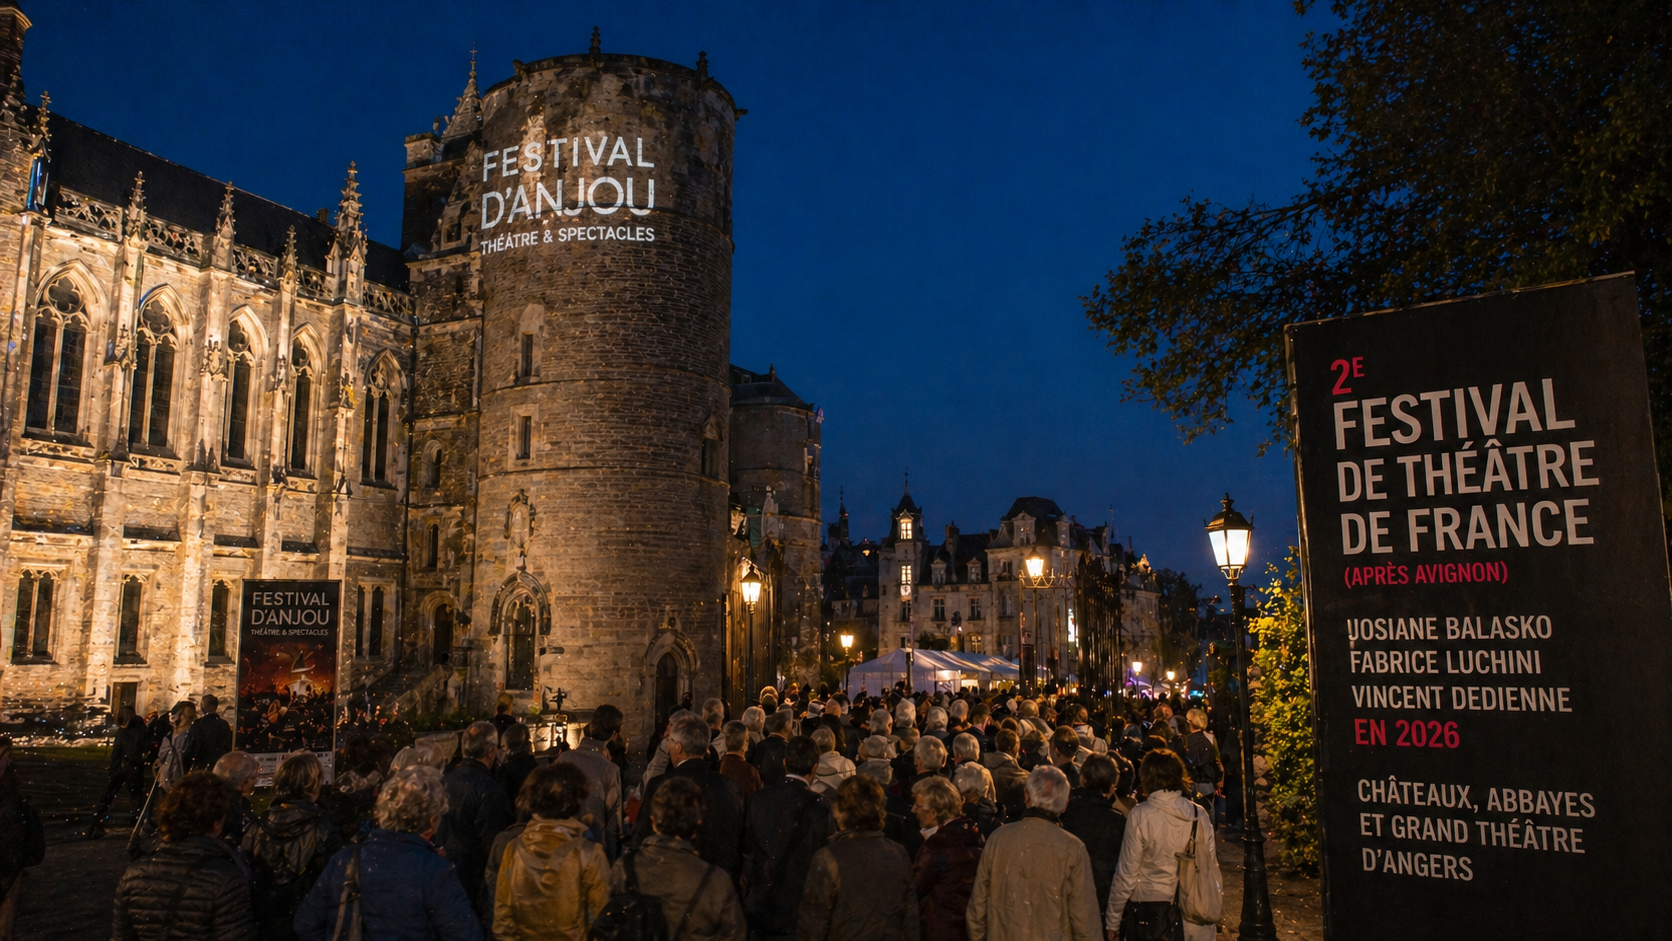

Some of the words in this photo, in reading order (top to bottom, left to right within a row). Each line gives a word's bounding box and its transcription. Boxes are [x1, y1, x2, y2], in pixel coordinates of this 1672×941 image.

[483, 136, 655, 182] FESTIVAL
[481, 176, 655, 230] D'ANJOU
[543, 229, 553, 243] &
[558, 226, 655, 242] SPECTACLES
[1333, 378, 1576, 450] FESTIVAL
[1337, 458, 1388, 502] DE
[1397, 438, 1600, 497] THÉÂTRE
[1340, 510, 1393, 555] DE
[1407, 498, 1595, 553] FRANCE
[1344, 561, 1409, 588] (APRÈS
[1415, 560, 1508, 585] AVIGNON)
[252, 591, 330, 606] FESTIVAL
[251, 609, 330, 626] D'ANJOU
[1348, 617, 1439, 641] JOSIANE
[1446, 615, 1553, 640] BALASKO
[1350, 650, 1439, 674] FABRICE
[1446, 649, 1541, 674] LUCHINI
[1351, 685, 1444, 710] VINCENT
[1452, 686, 1573, 713] DEDIENNE
[1354, 718, 1387, 746] EN
[1395, 719, 1460, 748] 2026
[1357, 774, 1479, 814] CHÂTEAUX,
[1487, 787, 1596, 818] ABBAYES
[1360, 812, 1384, 837] ET
[1391, 815, 1469, 844] GRAND
[1475, 818, 1586, 854] THÉÂTRE
[1362, 847, 1474, 881] D'ANGERS
